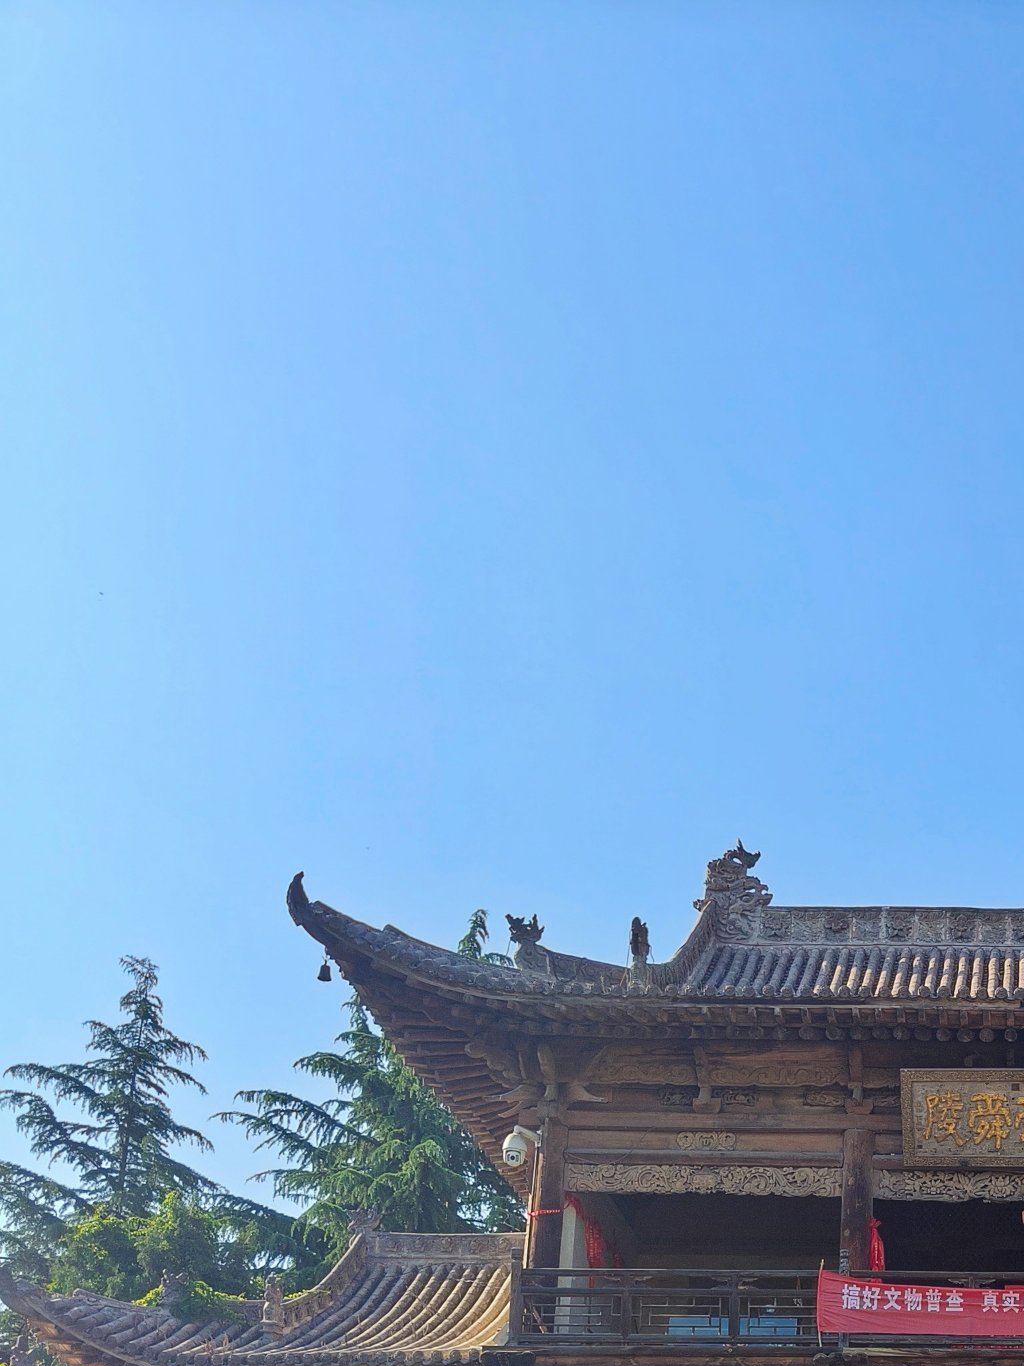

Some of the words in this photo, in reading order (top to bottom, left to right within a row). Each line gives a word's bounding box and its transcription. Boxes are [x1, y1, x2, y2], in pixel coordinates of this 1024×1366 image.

[840, 1283, 965, 1313] 搞好文物普查
